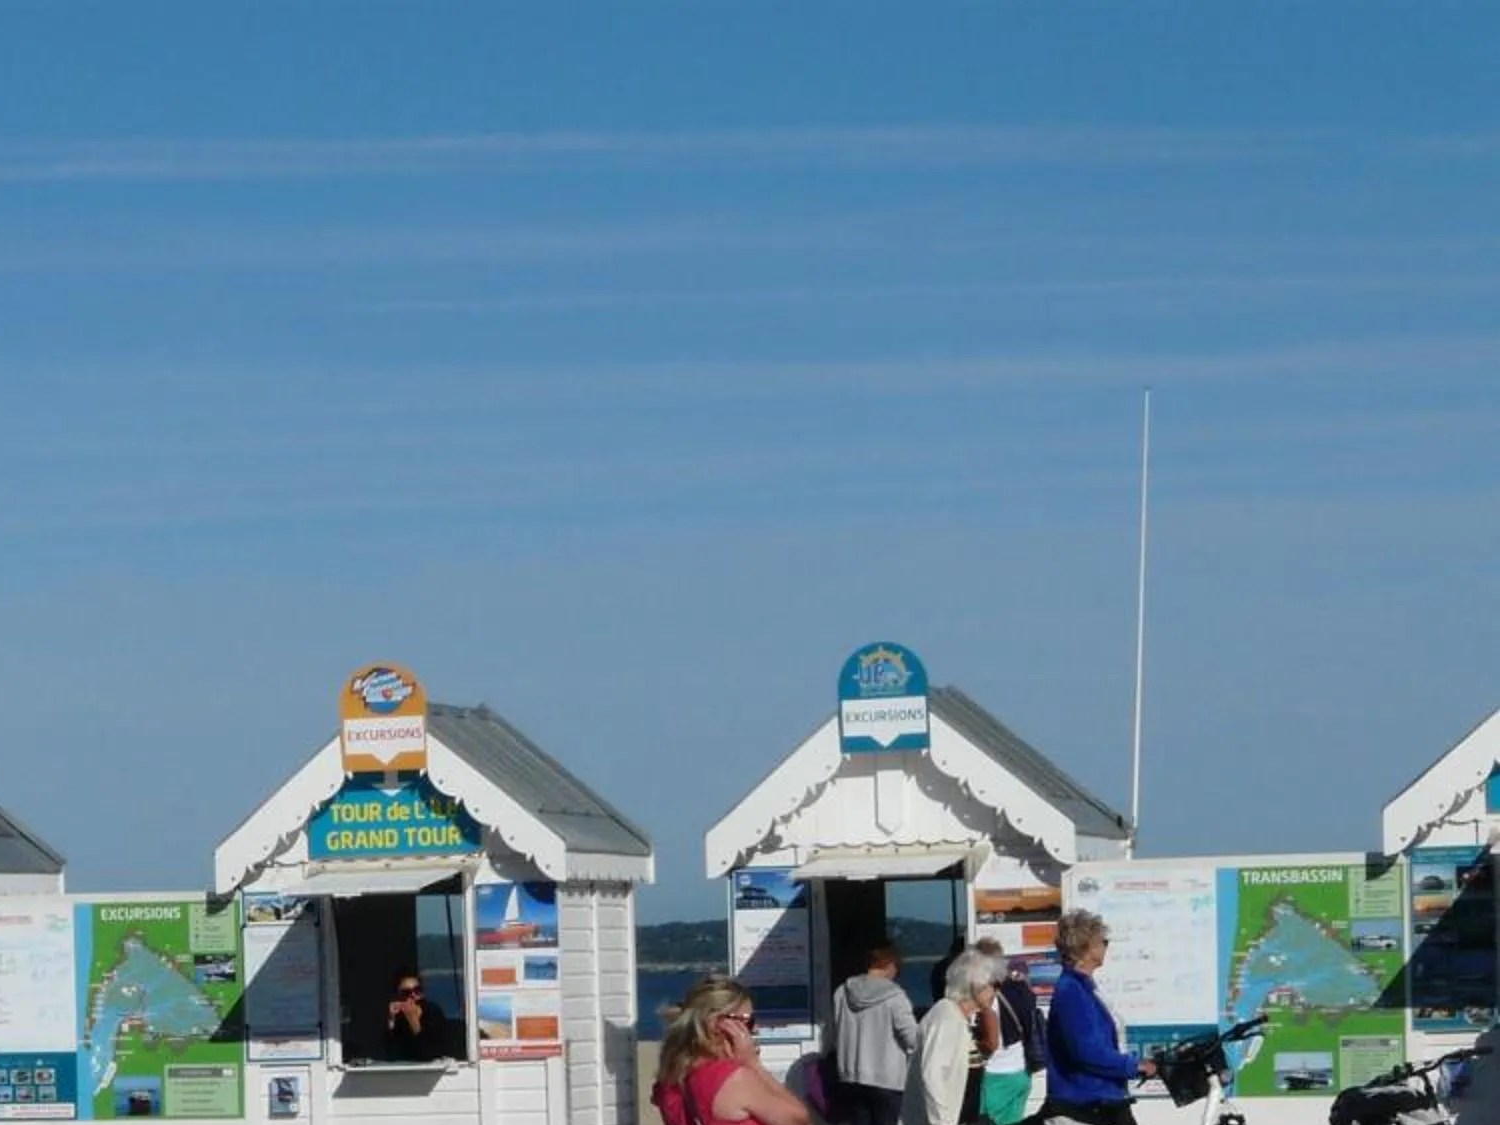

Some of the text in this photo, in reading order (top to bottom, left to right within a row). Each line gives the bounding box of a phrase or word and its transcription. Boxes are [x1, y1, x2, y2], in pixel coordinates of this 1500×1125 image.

[845, 708, 925, 723] EXCURSIONS
[348, 727, 423, 742] EXCURSIONS
[330, 801, 383, 824] TOUR
[387, 801, 411, 820] de
[326, 824, 462, 851] GRAND TOUR
[1241, 868, 1344, 885] TRANSBASSIN
[100, 906, 182, 921] EXCURSIONS
